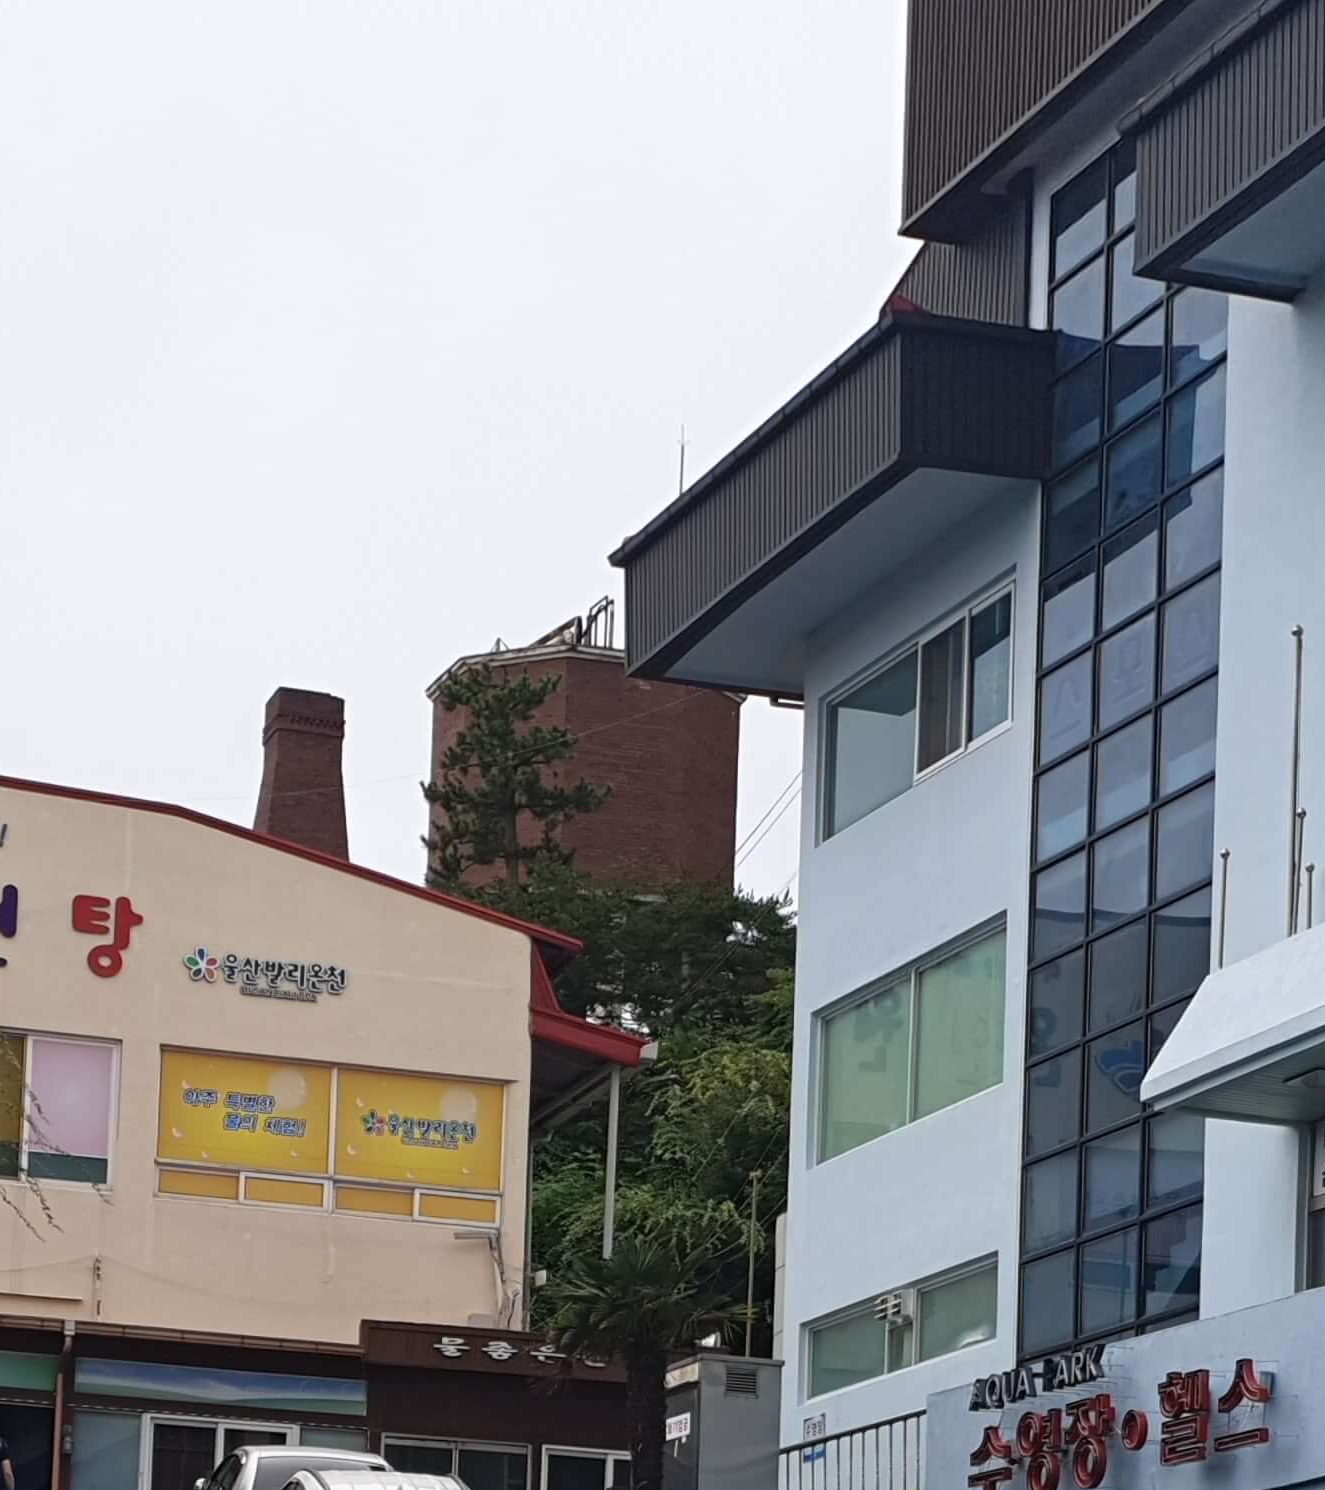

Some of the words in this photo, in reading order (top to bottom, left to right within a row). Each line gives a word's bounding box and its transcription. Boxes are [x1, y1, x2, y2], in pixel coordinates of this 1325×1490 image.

[223, 953, 348, 996] 울산발리온천
[183, 1088, 218, 1108] 아주
[969, 1366, 1037, 1412] AQUA
[1158, 1357, 1274, 1467] 헬스
